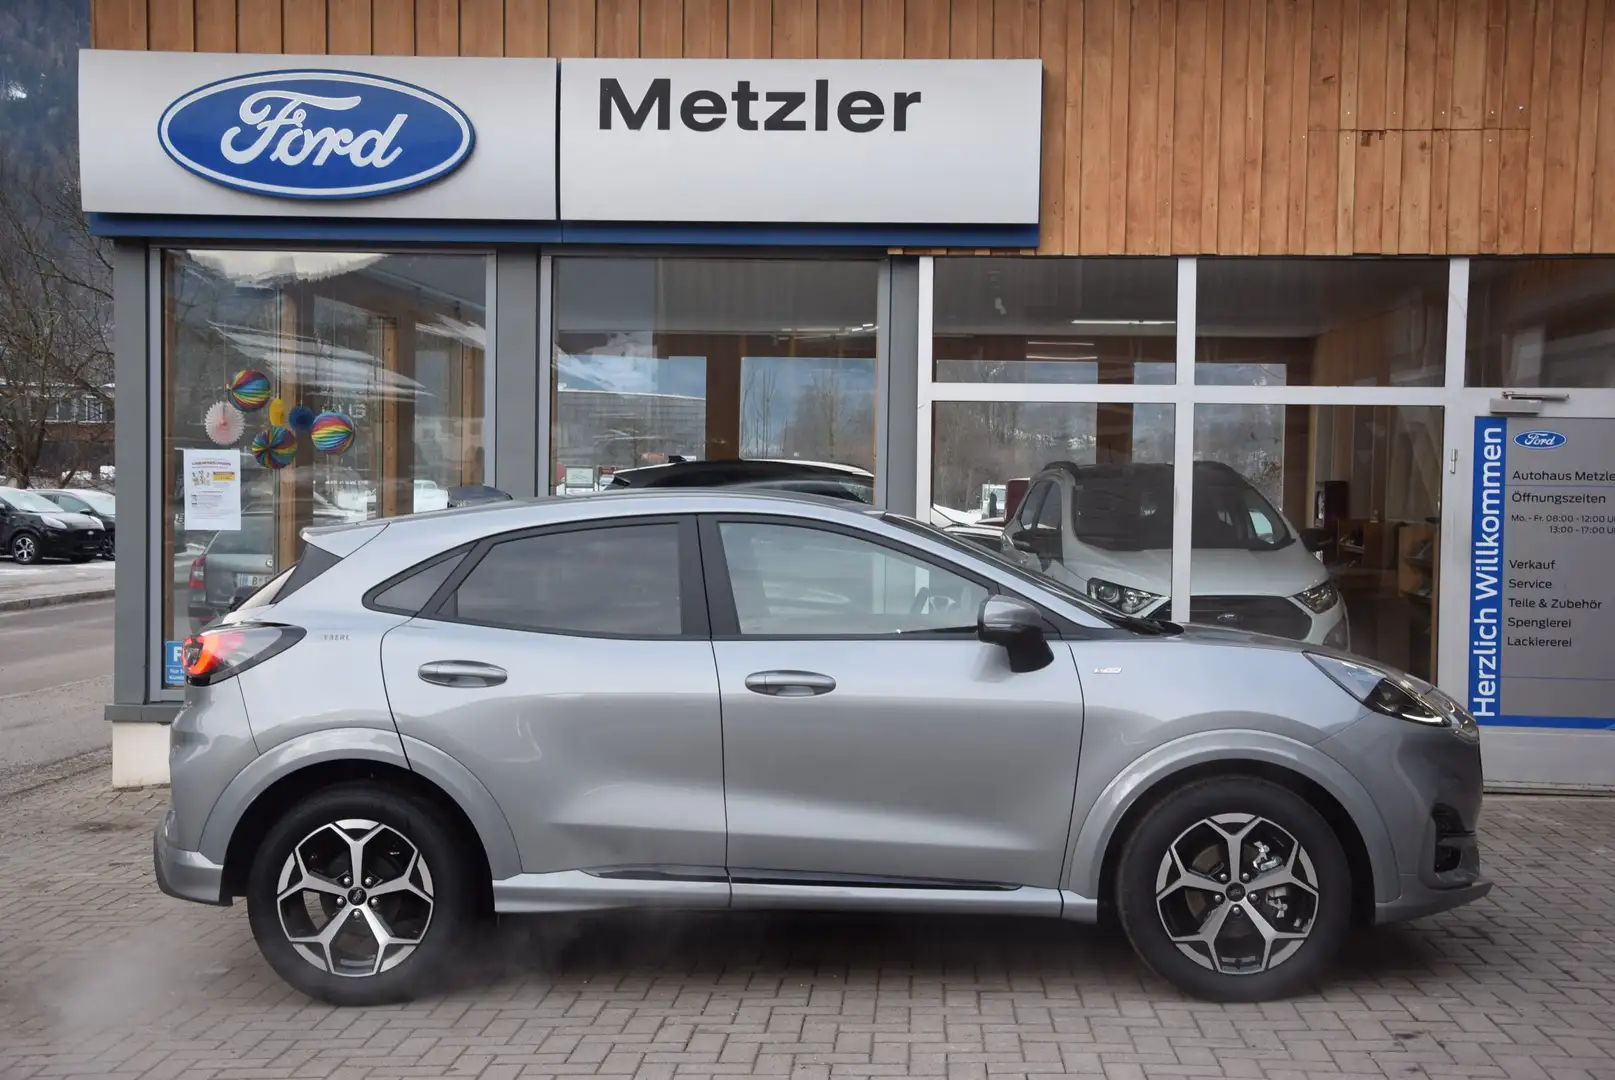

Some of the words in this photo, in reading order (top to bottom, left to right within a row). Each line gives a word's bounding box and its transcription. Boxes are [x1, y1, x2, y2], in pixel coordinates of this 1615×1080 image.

[599, 78, 921, 133] Metzler
[220, 90, 408, 168] Ford
[1524, 433, 1556, 446] Ford
[1512, 470, 1572, 481] Autohaus
[1511, 490, 1606, 505] Öffnungszeiten
[1475, 427, 1502, 600] Willkommen
[1546, 514, 1574, 523] 08:00
[1581, 515, 1605, 523] 12:00
[1549, 526, 1573, 534] 13:00
[1581, 526, 1605, 534] 17:00
[1508, 559, 1556, 570] Verkauf
[1508, 578, 1552, 589] Service
[1508, 598, 1536, 608] Teile
[1538, 598, 1548, 608] &
[1551, 598, 1602, 609] Zubehör
[1507, 617, 1572, 629] Spenglerei
[1506, 636, 1572, 648] Lackiererei
[1473, 608, 1497, 716] Herzlich
